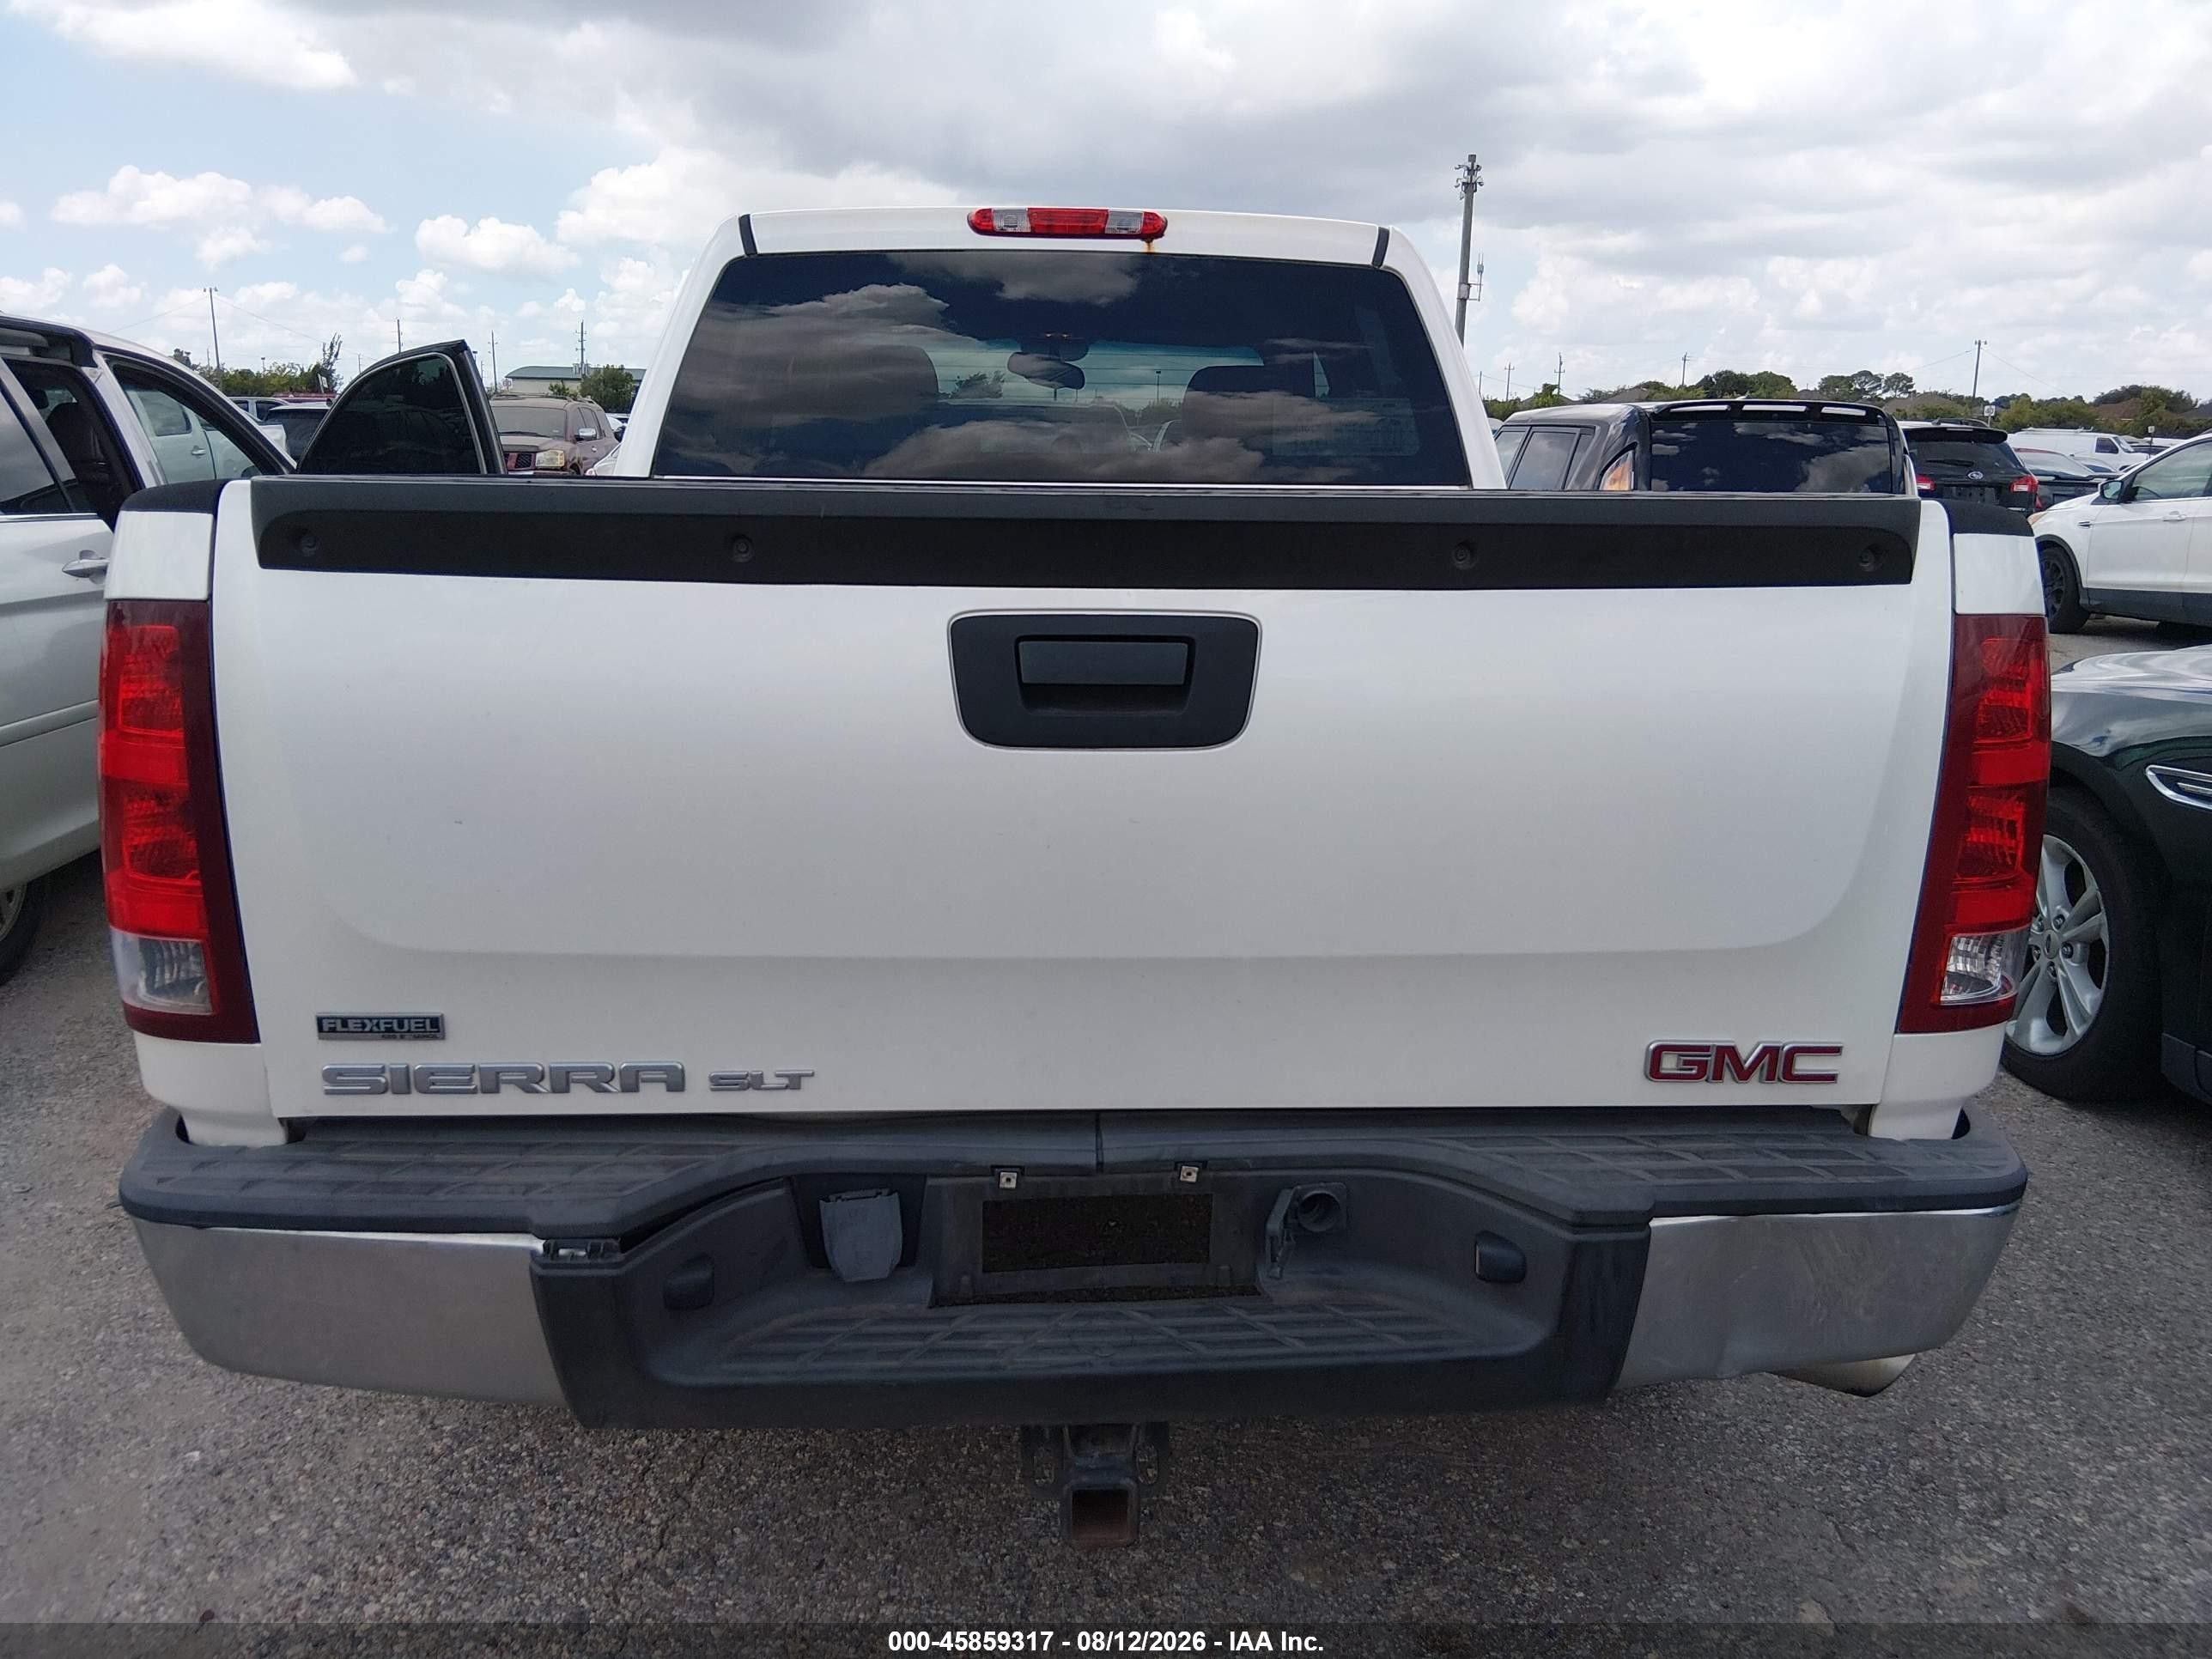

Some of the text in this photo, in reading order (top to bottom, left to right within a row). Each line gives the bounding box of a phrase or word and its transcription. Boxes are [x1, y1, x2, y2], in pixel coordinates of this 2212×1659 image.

[322, 1018, 439, 1031] FLEXFUEL
[322, 1062, 816, 1095] SIERRA SLT
[1644, 1040, 1844, 1084] GMC
